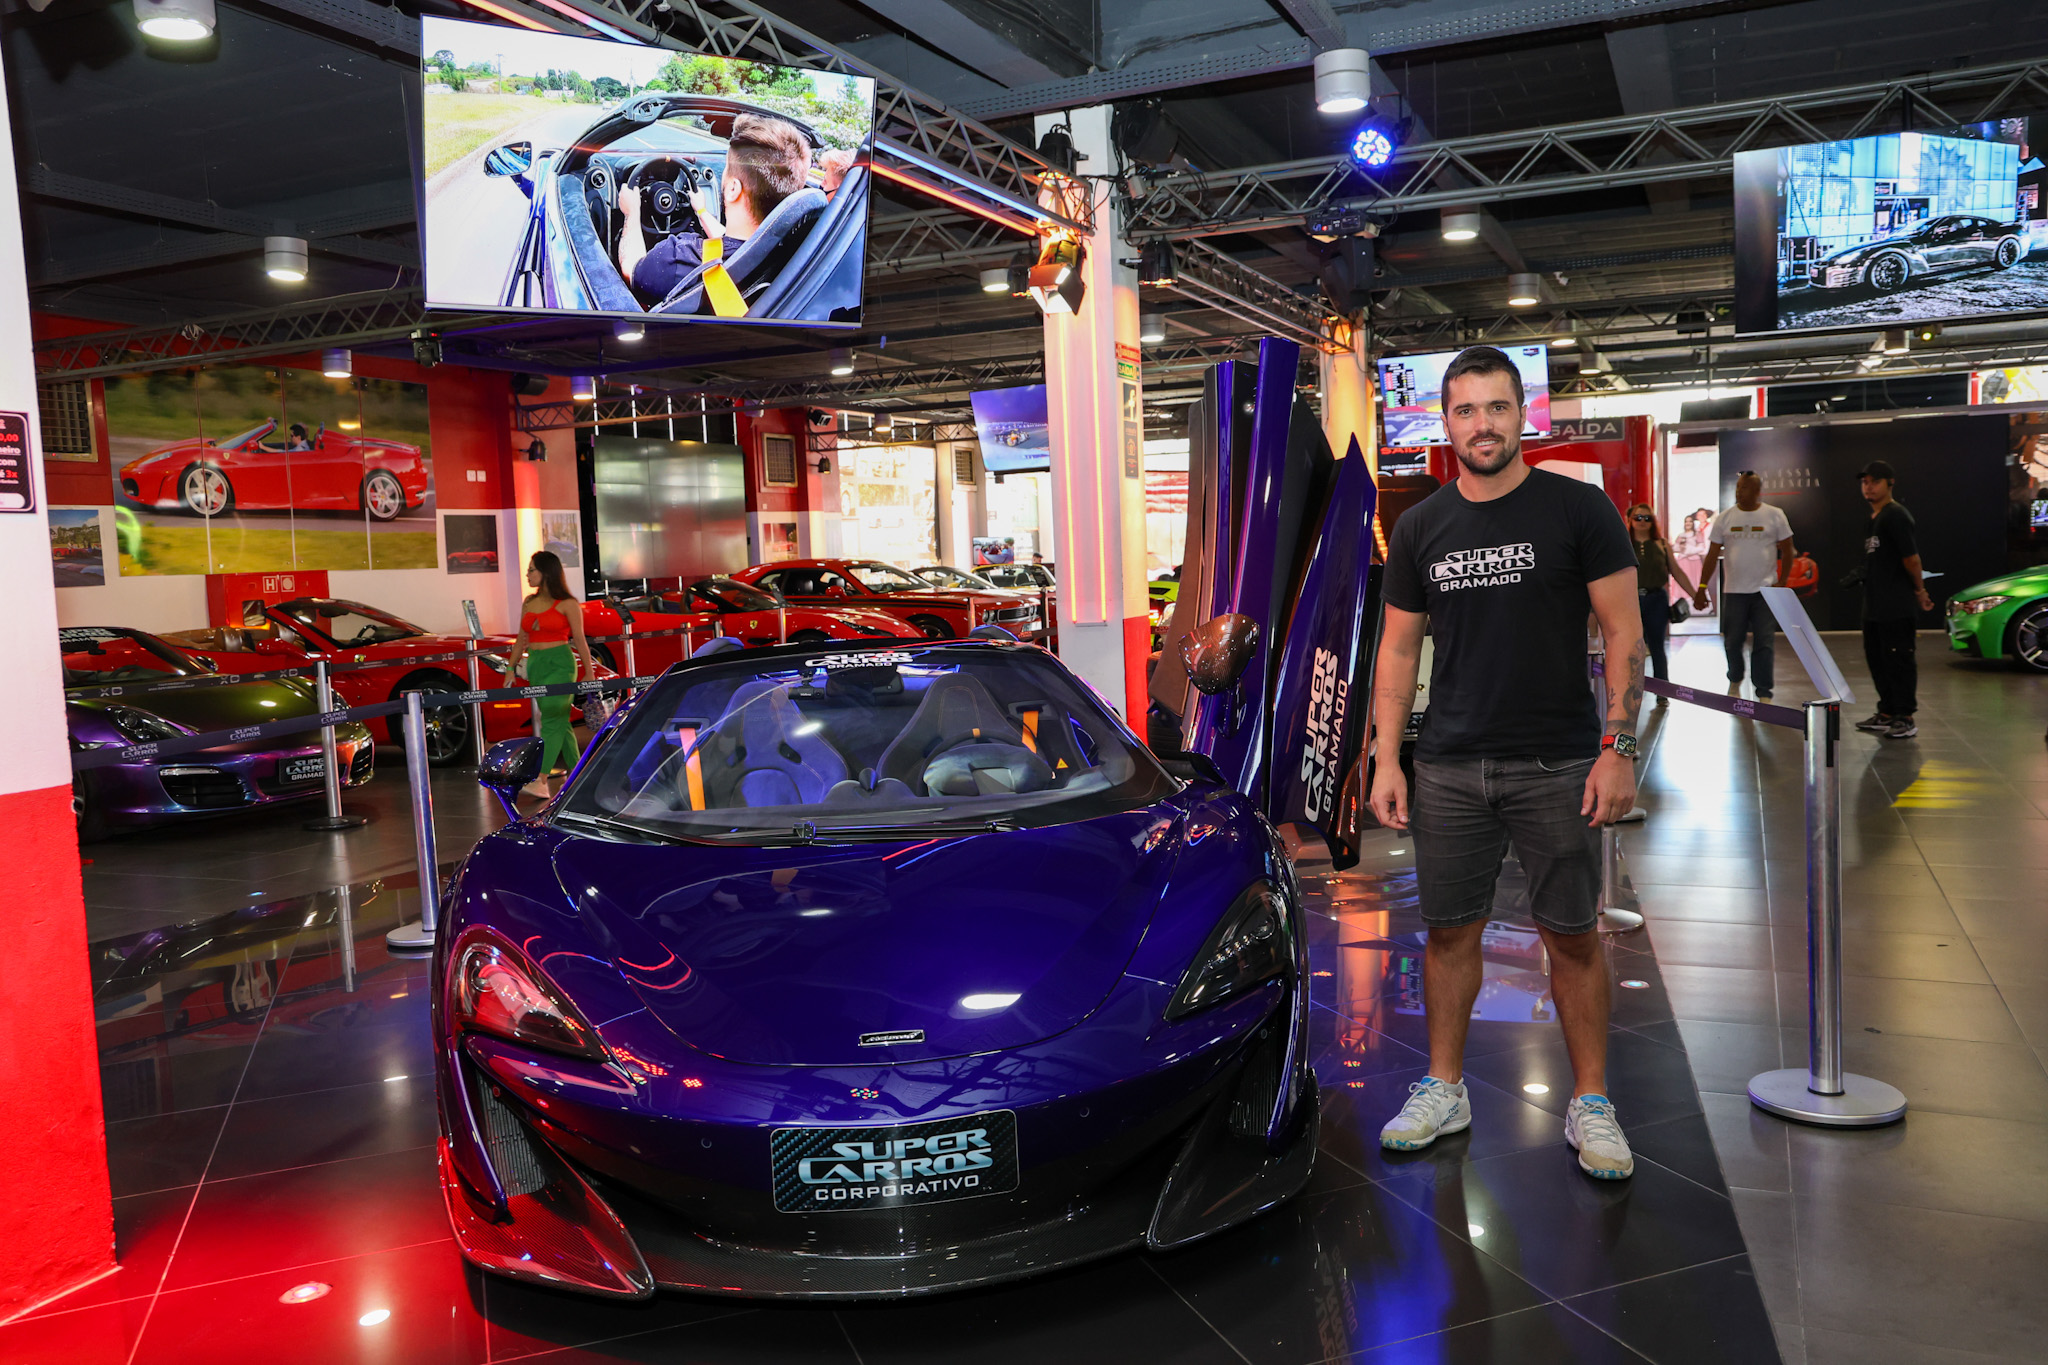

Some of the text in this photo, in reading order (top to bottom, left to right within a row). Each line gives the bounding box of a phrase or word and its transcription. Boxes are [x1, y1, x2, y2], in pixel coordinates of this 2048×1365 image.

[5, 470, 18, 478] 3x
[1446, 543, 1534, 563] SUPER
[1430, 557, 1535, 581] CARROS
[266, 578, 275, 591] H
[1440, 572, 1521, 592] GRAMADO
[805, 656, 913, 668] CARROS
[1301, 646, 1328, 782] SUPER
[1305, 650, 1338, 822] CARROS
[1323, 678, 1348, 813] GRAMADO
[286, 764, 324, 775] CARRO
[295, 758, 324, 767] SUPE
[291, 771, 324, 780] GRAMAD
[832, 1128, 991, 1161] SUPER
[798, 1148, 993, 1184] CARROS
[815, 1174, 979, 1201] CORPORATIVO
